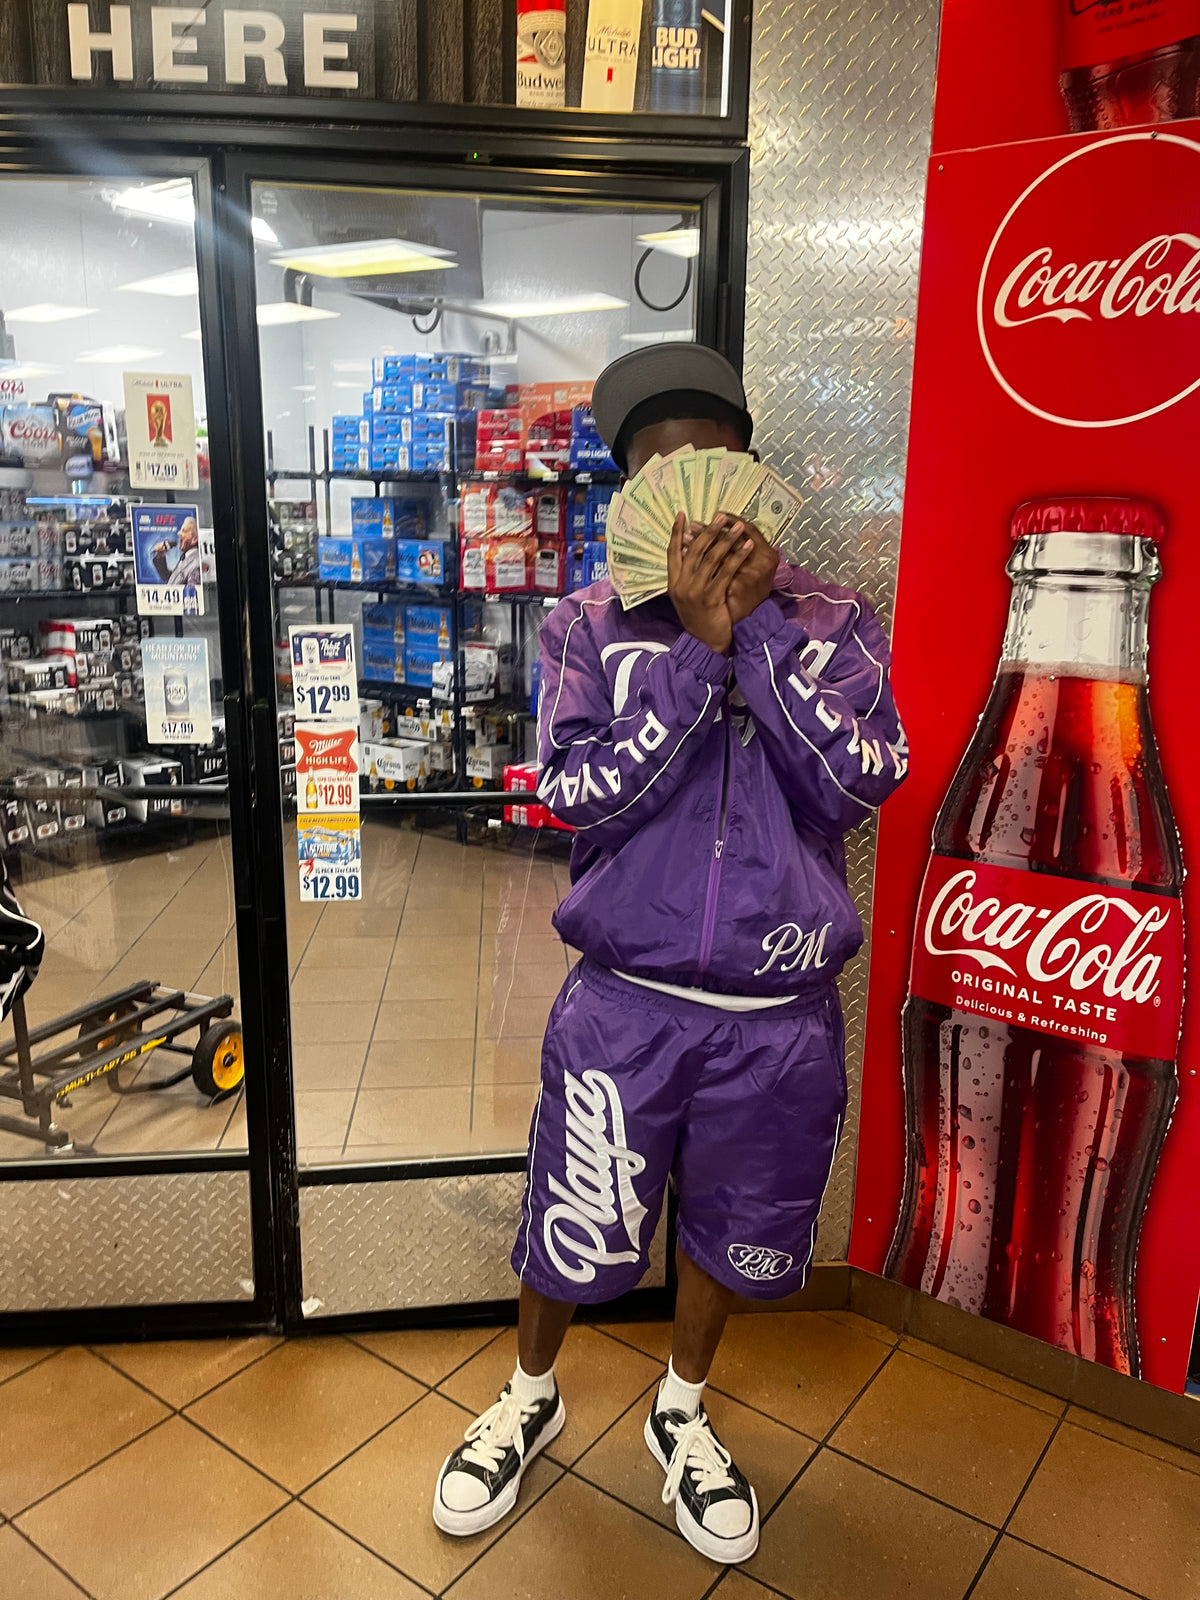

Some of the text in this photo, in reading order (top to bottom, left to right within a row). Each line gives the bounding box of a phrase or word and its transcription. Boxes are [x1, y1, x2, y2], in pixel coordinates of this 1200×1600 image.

[67, 3, 359, 89] HERE
[588, 37, 637, 57] ULTRA
[656, 26, 698, 48] BUD
[652, 46, 701, 69] LIGHT
[9, 421, 58, 441] Coors
[309, 737, 343, 756] Miller
[306, 755, 348, 765] HIGH LIFE
[319, 783, 352, 806] $12.99
[303, 875, 360, 898] $12.99
[924, 870, 1170, 1003] Coca-Cola
[753, 922, 833, 977] PM
[951, 970, 1117, 1022] ORIGINAL TASTE
[956, 995, 1108, 1043] Delicious & Refreshing
[543, 1069, 648, 1284] Playa
